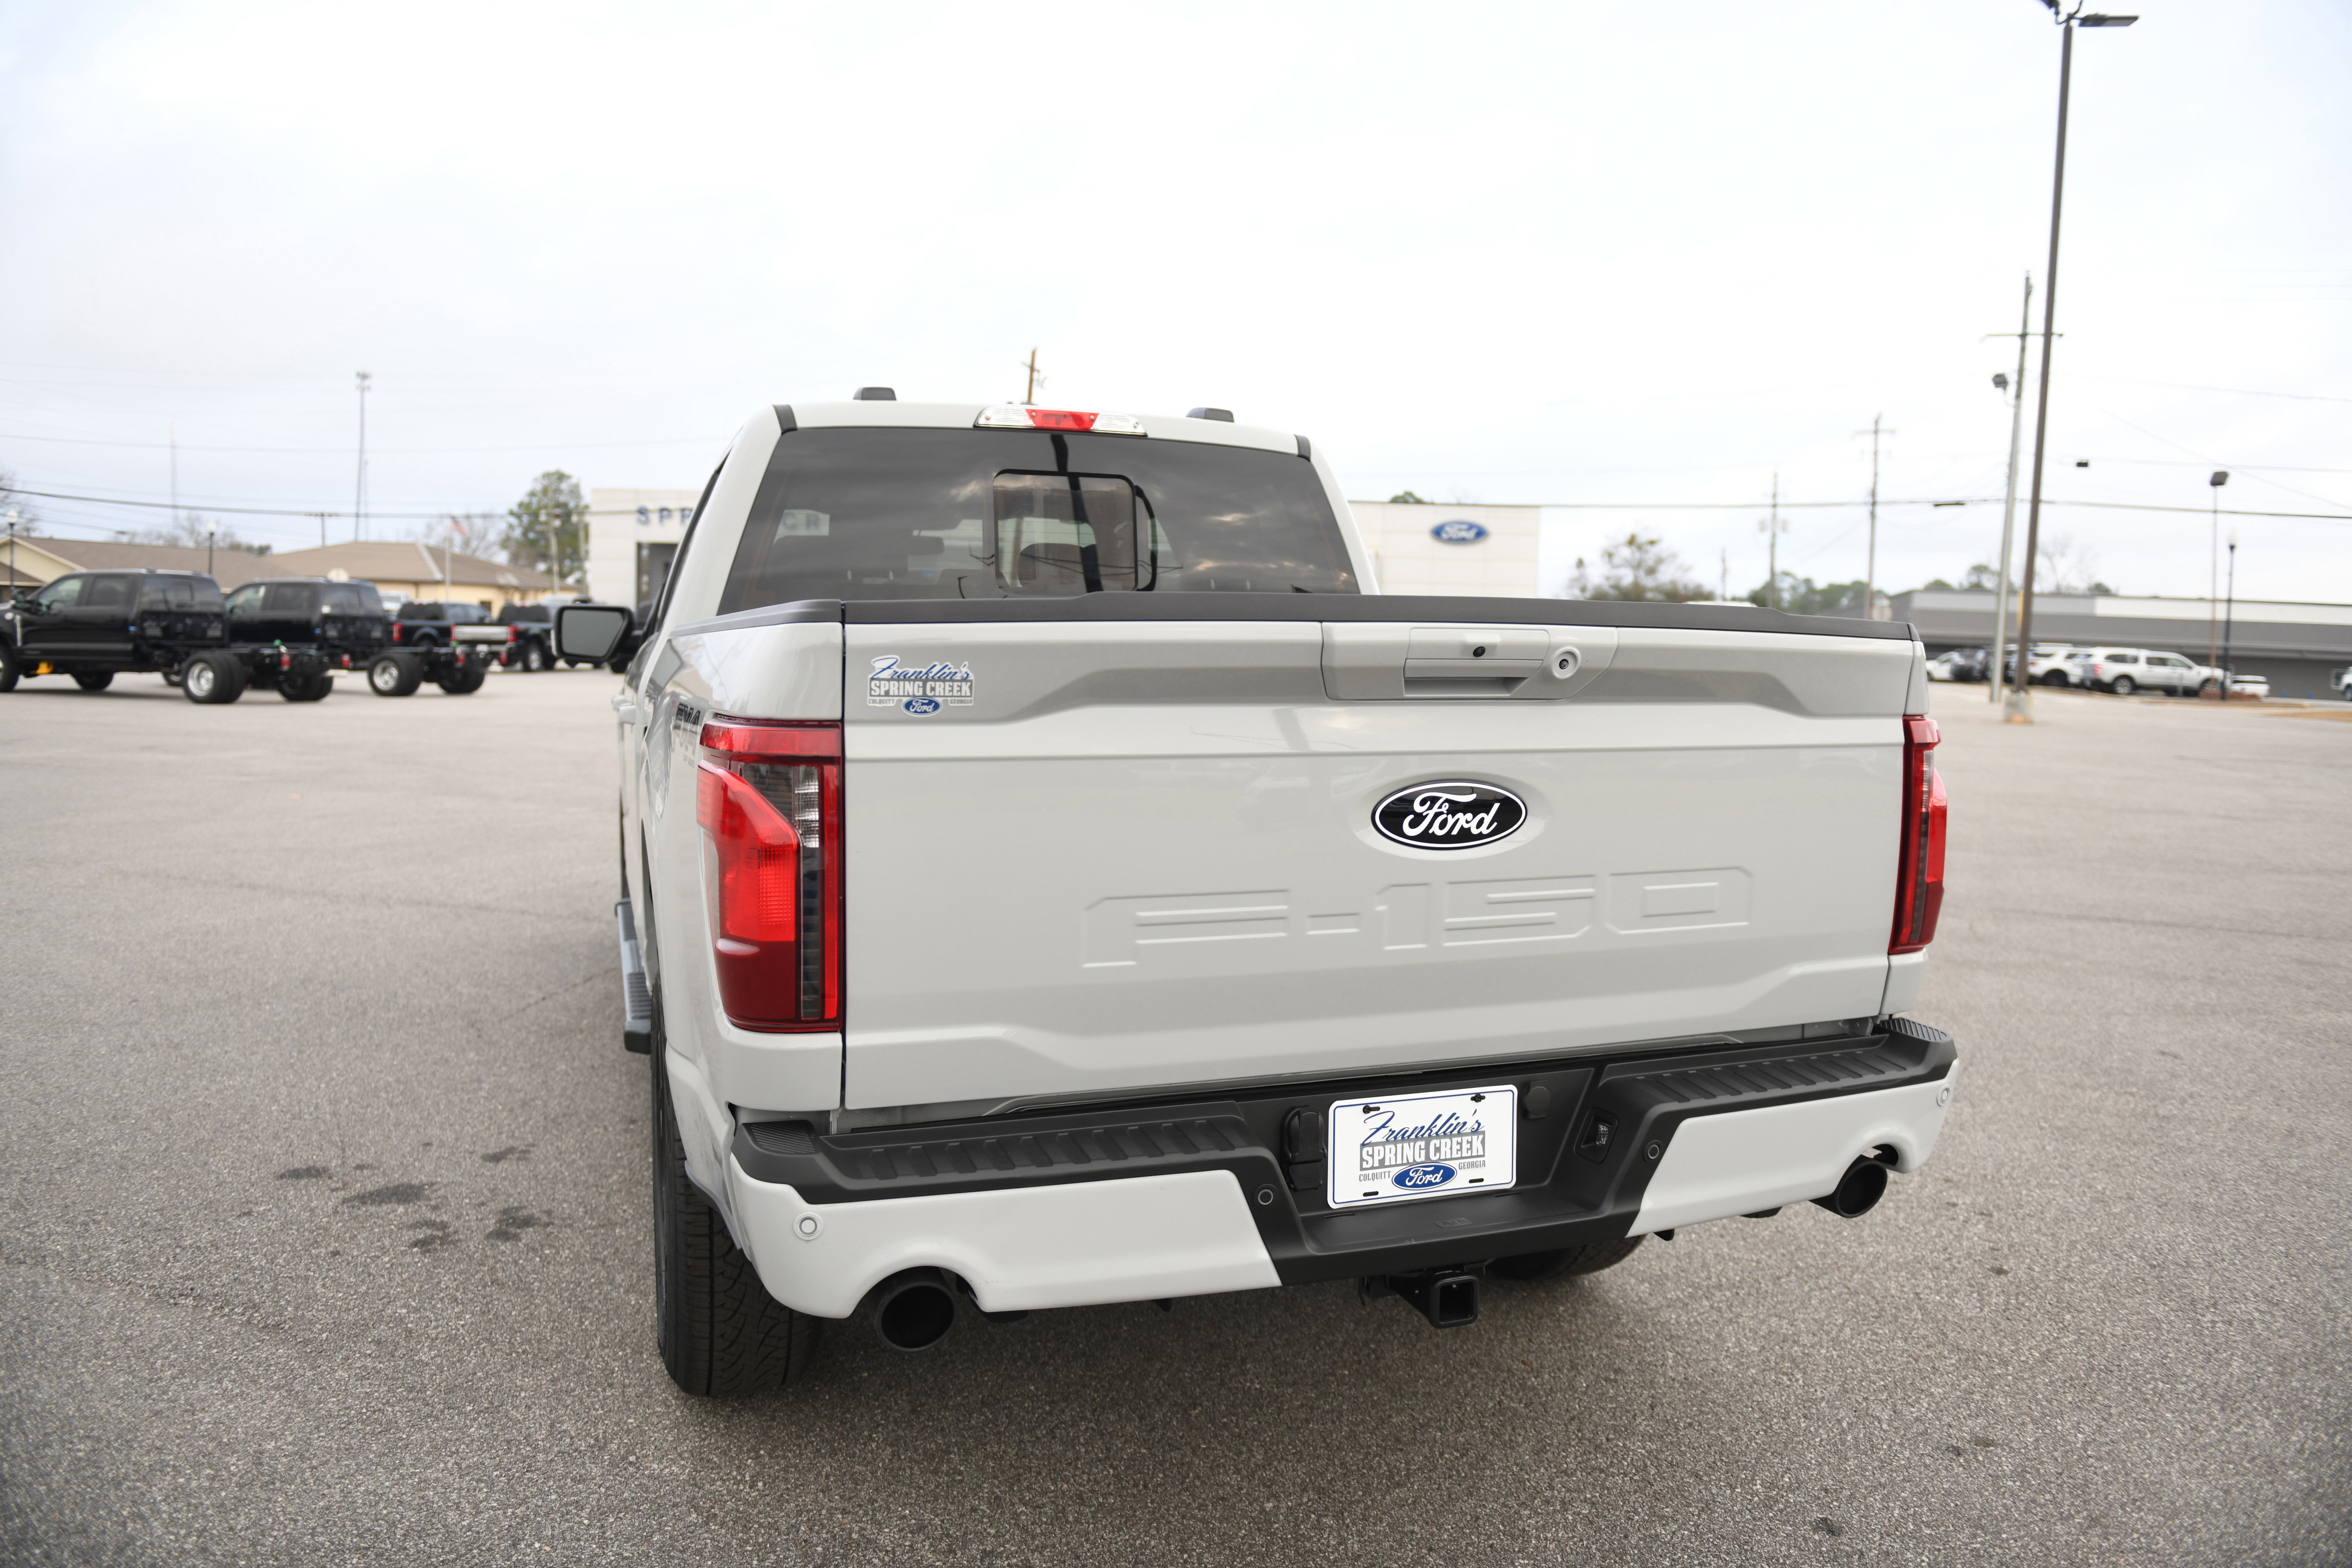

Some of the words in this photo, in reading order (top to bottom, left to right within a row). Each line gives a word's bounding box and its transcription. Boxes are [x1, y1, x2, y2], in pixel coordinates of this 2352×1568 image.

[1440, 523, 1478, 541] Ford
[870, 657, 972, 680] Franklin's
[871, 680, 923, 696] SPRING
[926, 681, 971, 696] CREEK
[909, 699, 935, 713] Ford
[1403, 792, 1500, 836] Ford
[1081, 866, 1753, 968] F-150
[1361, 1109, 1485, 1146] Franklin's
[1362, 1141, 1426, 1169] SPRING
[1429, 1135, 1484, 1160] CREEK
[1458, 1160, 1486, 1170] GEORGIA
[1359, 1171, 1392, 1182] COLQUITT
[1405, 1167, 1444, 1186] Ford
